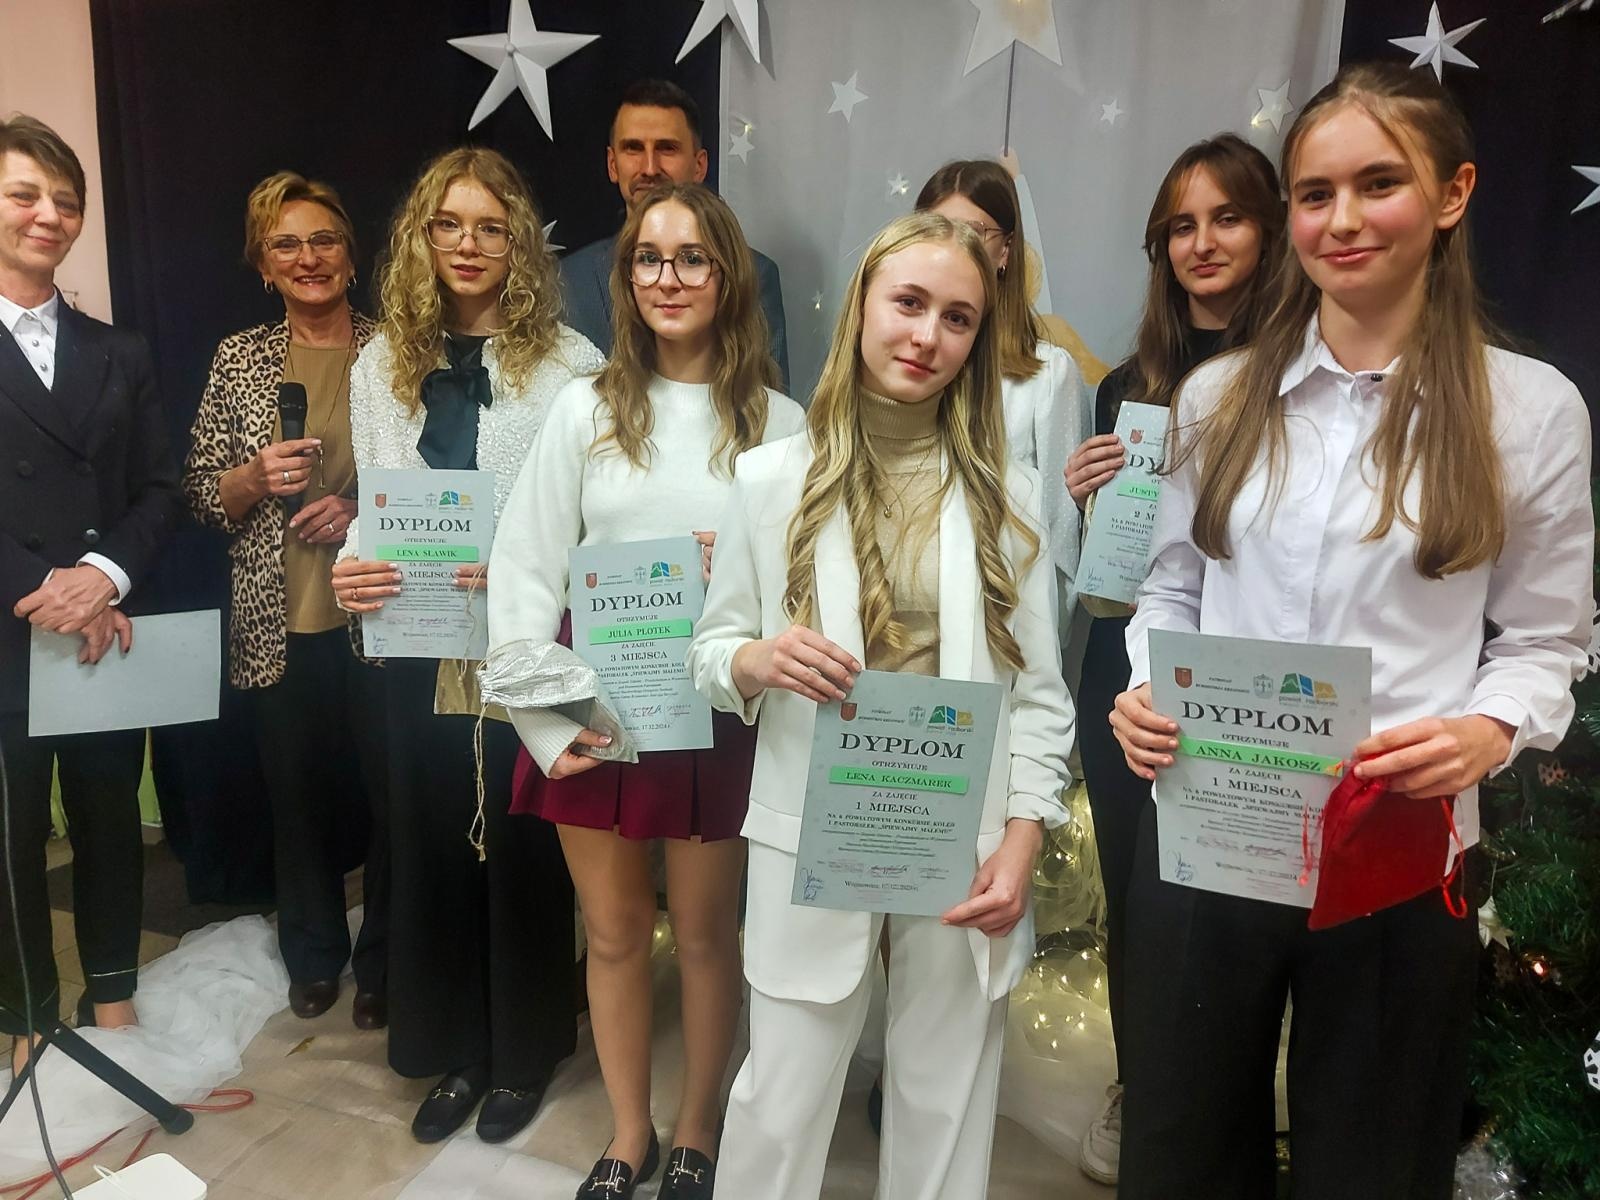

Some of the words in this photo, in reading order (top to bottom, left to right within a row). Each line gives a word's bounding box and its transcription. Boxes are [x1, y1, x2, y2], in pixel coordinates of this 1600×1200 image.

[379, 517, 473, 532] DYPLOM
[396, 549, 420, 557] LENA
[408, 571, 455, 579] MIEJSCA
[590, 591, 684, 612] DYPLOM
[608, 629, 633, 639] JULIA
[610, 654, 616, 662] 3
[621, 651, 668, 661] MIEJSCA
[1180, 700, 1334, 737] DYPLOM
[839, 732, 965, 759] DYPLOM
[1222, 733, 1289, 749] OTRZYMUJE
[871, 760, 928, 771] OTRZYMUJE
[1196, 745, 1243, 761] ANNA
[1251, 753, 1321, 772] JAKOSZ
[1228, 766, 1241, 775] ZA
[846, 772, 876, 782] LENA
[882, 775, 952, 788] KACZMAREK
[1212, 777, 1219, 787] 1
[1228, 779, 1303, 800] MIEJSCA
[856, 802, 861, 810] 1
[869, 802, 930, 815] MIEJSCA
